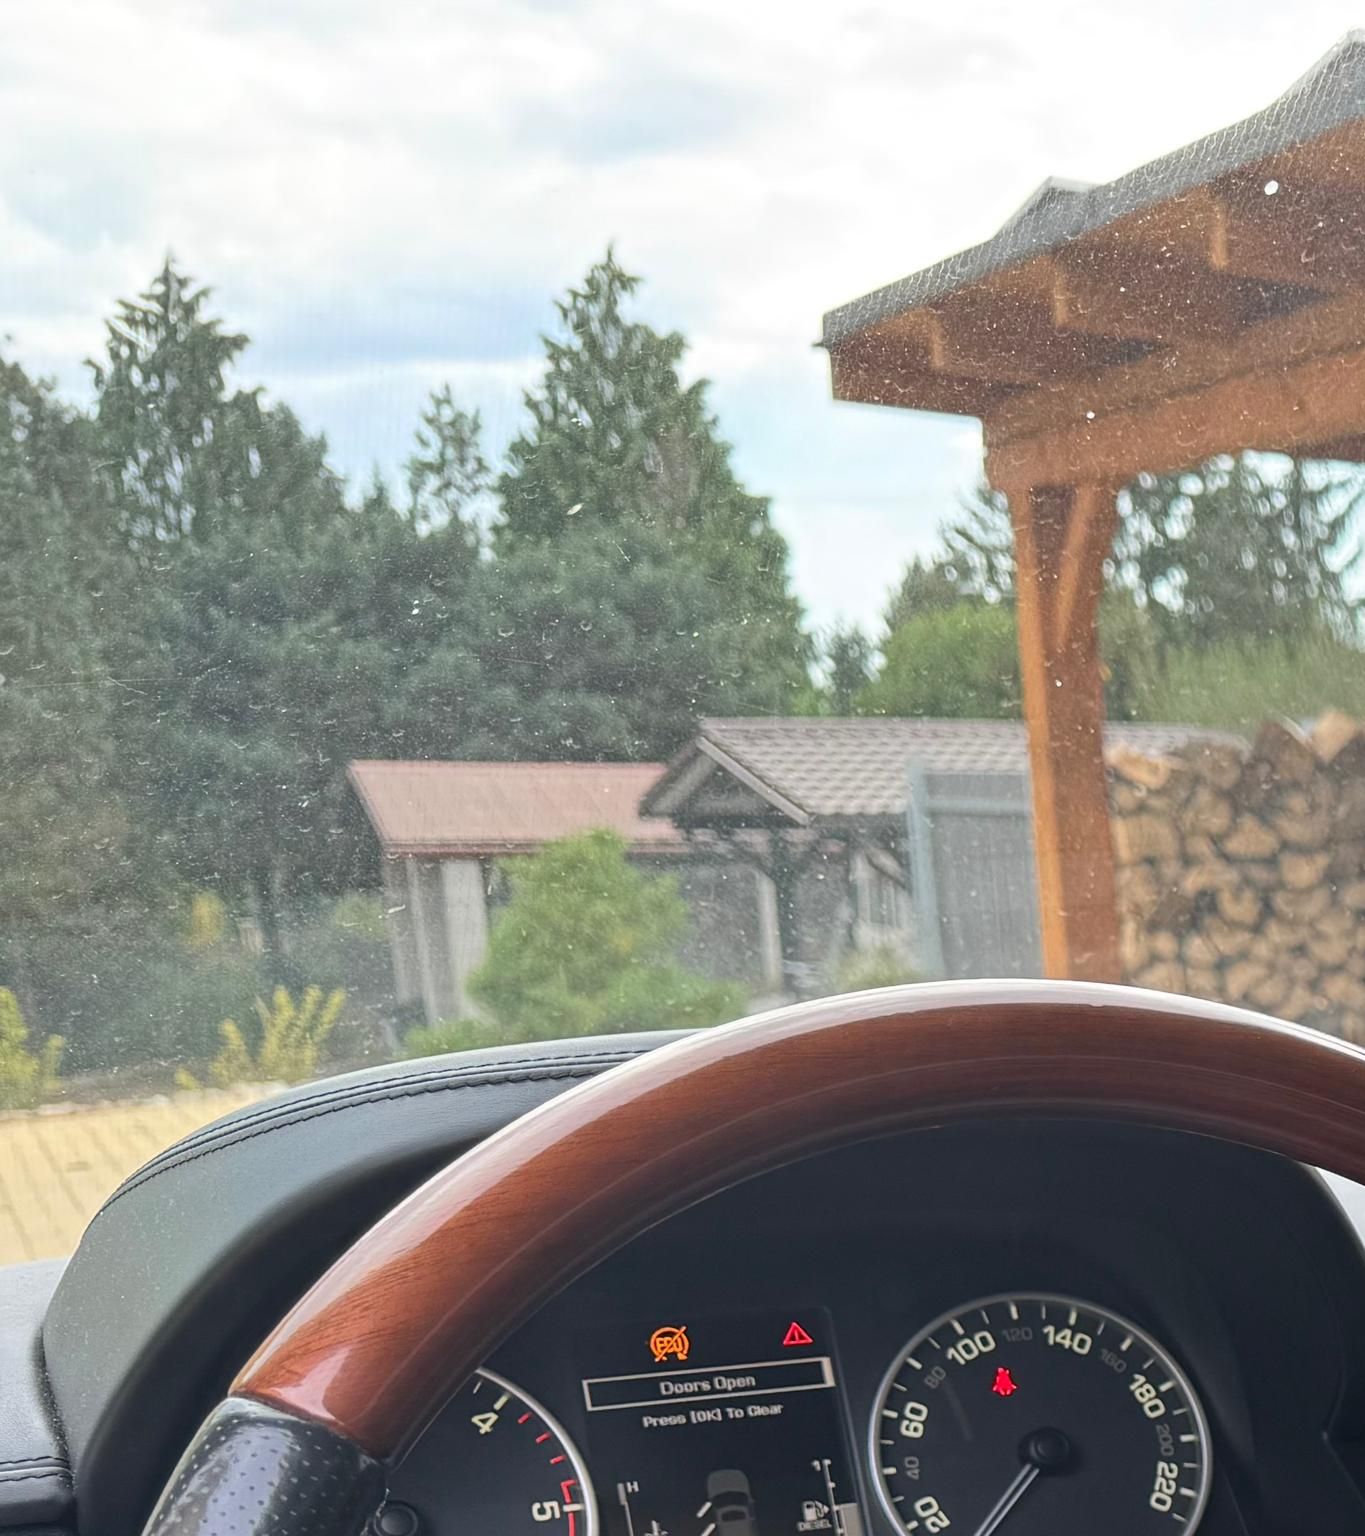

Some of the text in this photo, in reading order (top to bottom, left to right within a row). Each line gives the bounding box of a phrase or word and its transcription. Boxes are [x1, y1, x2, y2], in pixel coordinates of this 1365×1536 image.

[1002, 1327, 1033, 1342] 120
[1042, 1325, 1092, 1355] 140
[946, 1330, 997, 1365] 100
[1101, 1349, 1127, 1373] 160
[659, 1375, 756, 1396] Doors Open
[924, 1366, 947, 1389] 80
[1129, 1373, 1165, 1418] 180
[471, 1411, 499, 1434] 4
[642, 1412, 687, 1428] Press
[727, 1406, 745, 1419] To
[747, 1403, 784, 1417] Clear
[900, 1401, 928, 1438] 60
[1155, 1423, 1174, 1456] 200
[904, 1456, 920, 1480] 40
[626, 1481, 640, 1493] H
[1150, 1461, 1178, 1512] 220
[531, 1500, 560, 1522] 5
[914, 1496, 951, 1533] 20
